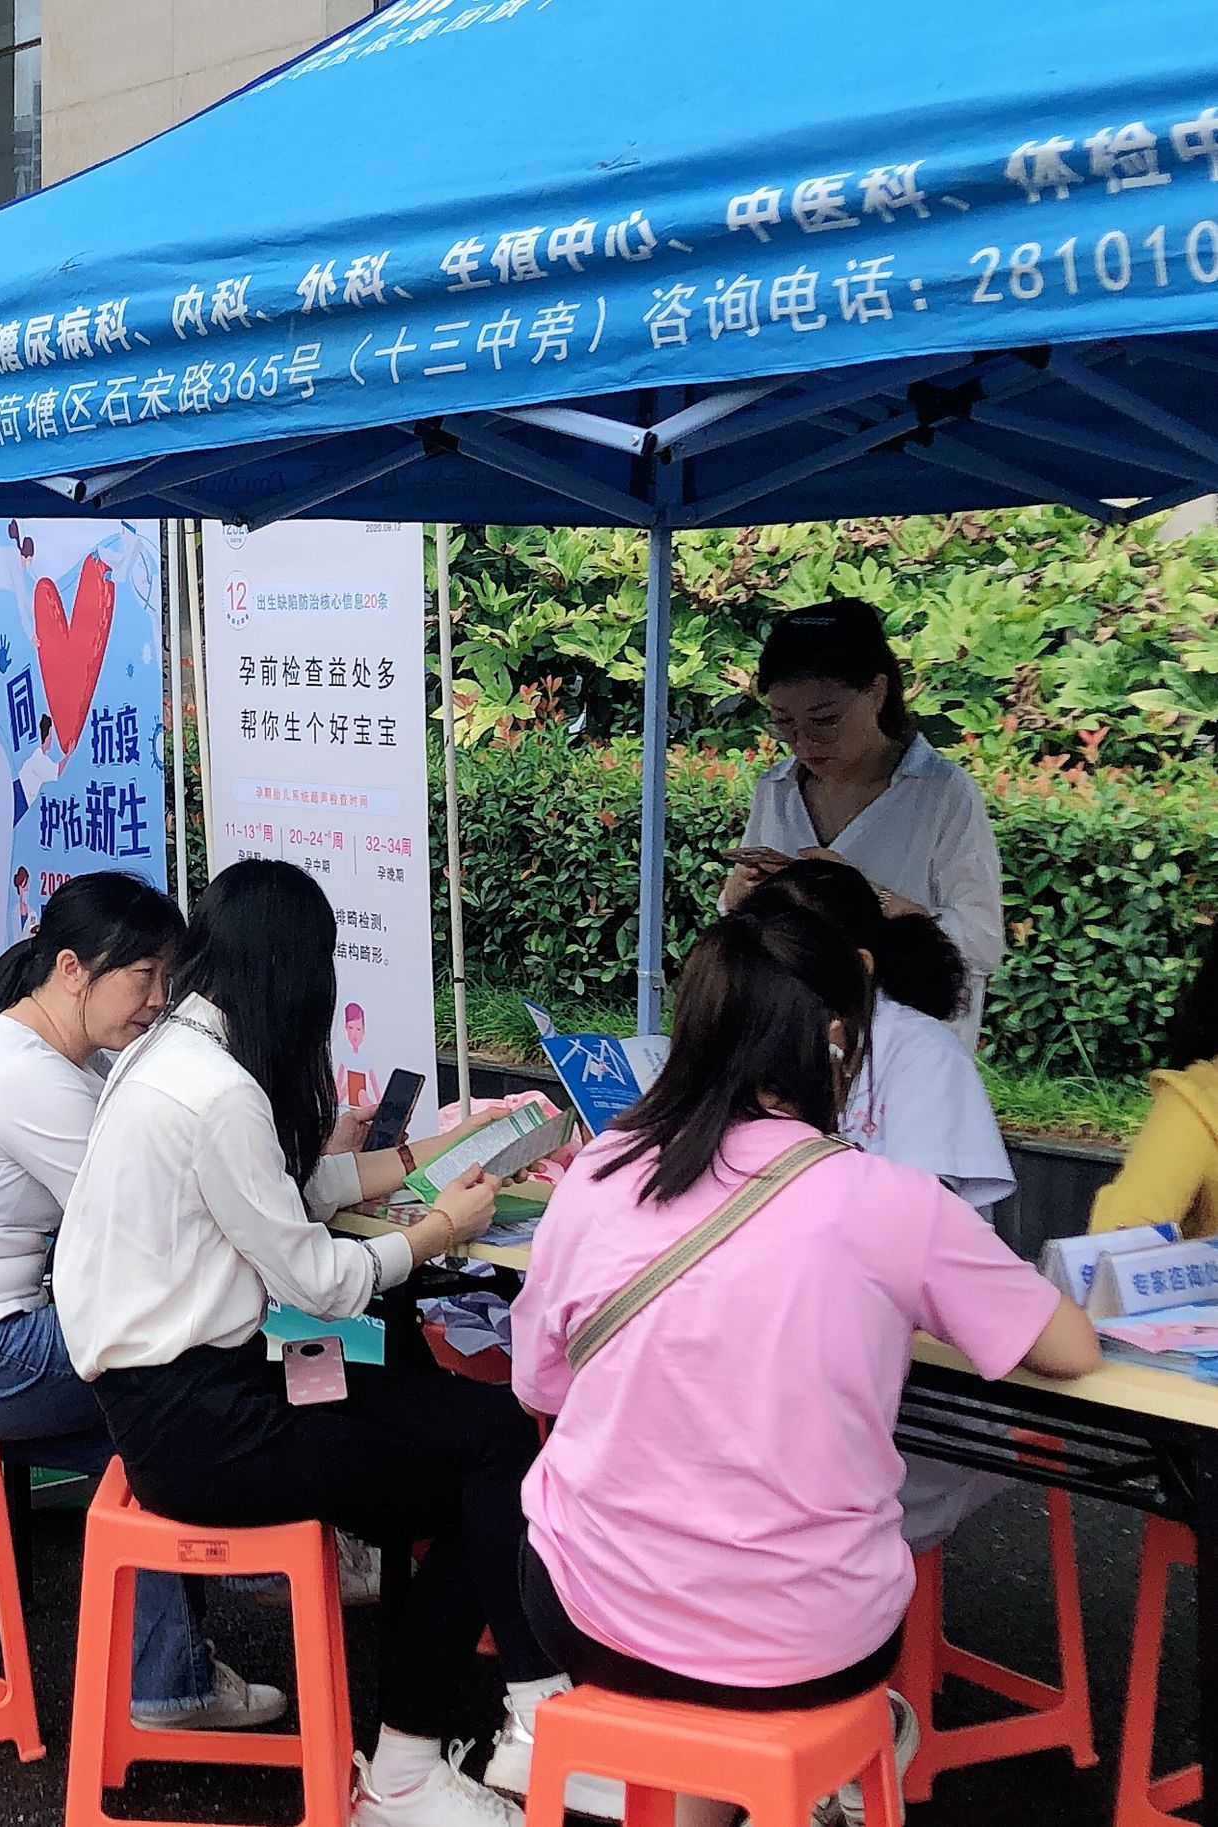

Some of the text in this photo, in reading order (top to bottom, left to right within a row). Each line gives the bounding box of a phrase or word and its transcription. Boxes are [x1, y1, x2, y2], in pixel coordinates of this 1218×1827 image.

[227, 582, 247, 611] 12
[256, 592, 389, 612] 出生缺陷防治核心信息20条
[239, 654, 396, 690] 孕前检查益处多
[90, 704, 142, 766] 抗疫
[240, 708, 397, 747] 帮你生个好宝宝
[39, 779, 151, 858] 护佑新生
